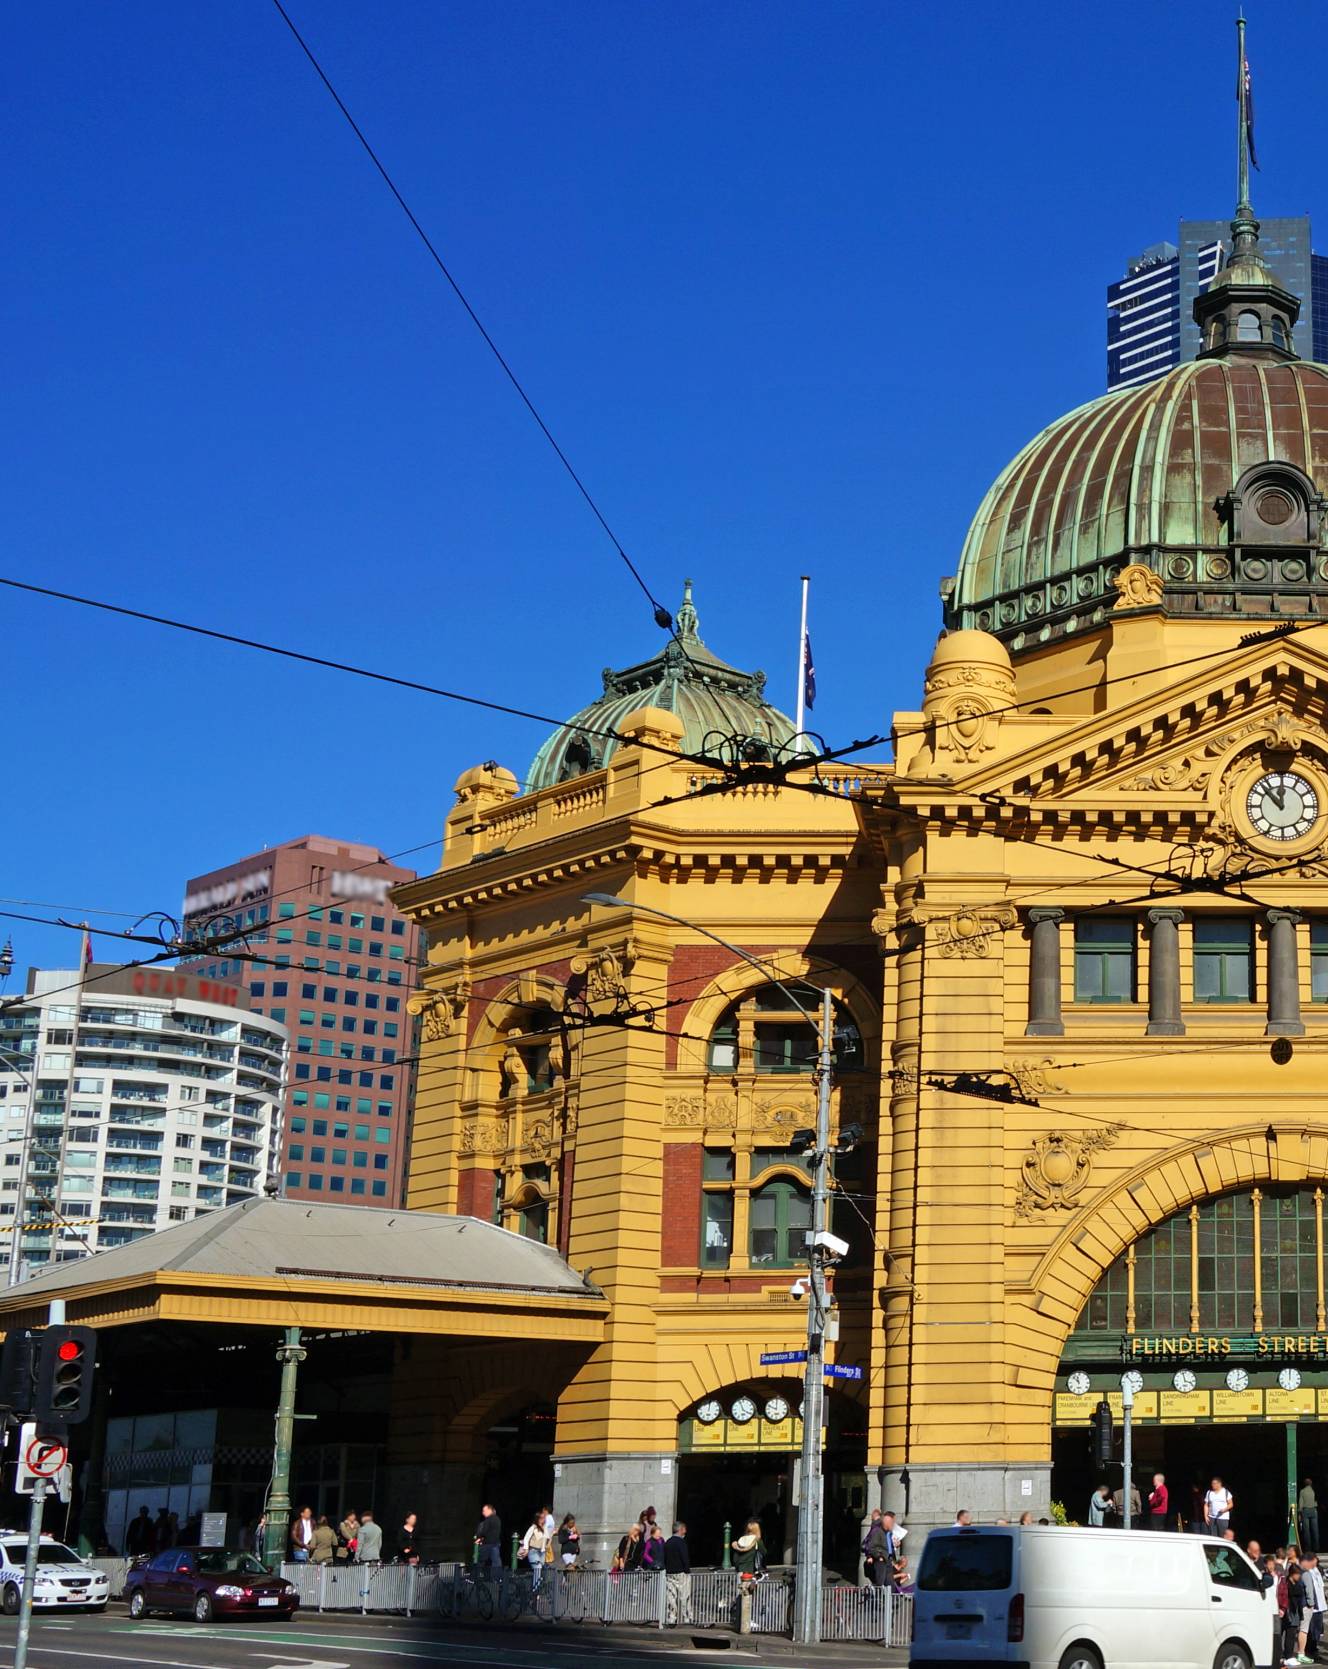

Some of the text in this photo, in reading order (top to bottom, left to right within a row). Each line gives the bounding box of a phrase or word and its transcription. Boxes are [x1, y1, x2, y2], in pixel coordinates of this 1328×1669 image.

[1131, 1336, 1231, 1355] FLINDERS
[761, 1351, 795, 1362] Swanston St
[834, 1365, 854, 1375] Flinders
